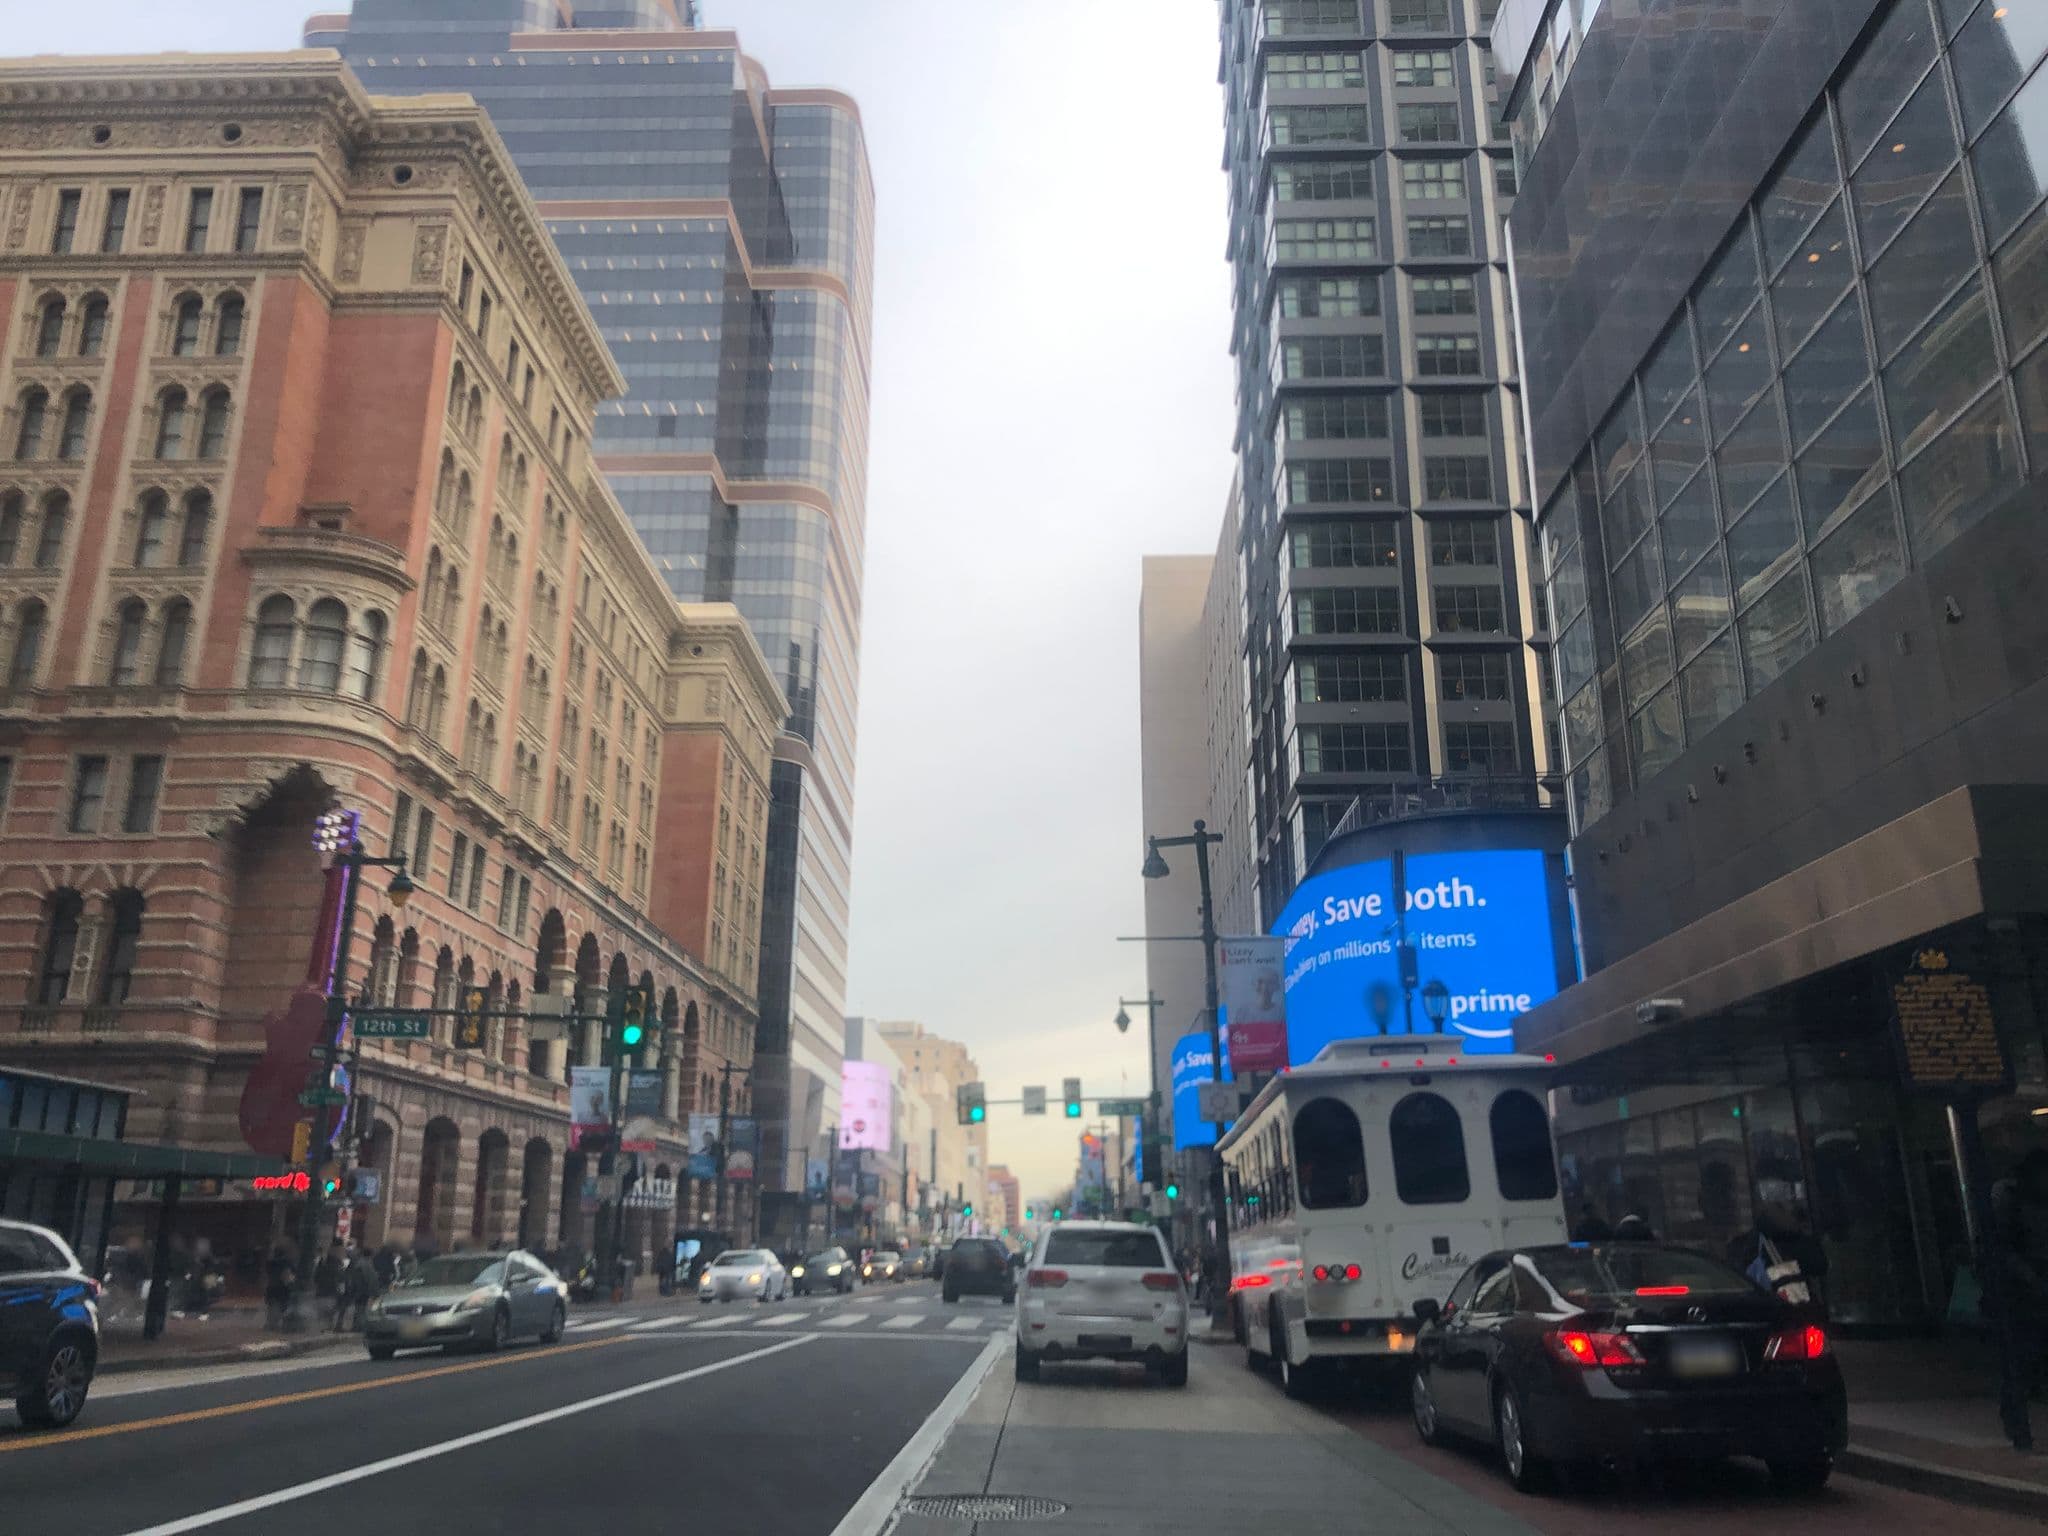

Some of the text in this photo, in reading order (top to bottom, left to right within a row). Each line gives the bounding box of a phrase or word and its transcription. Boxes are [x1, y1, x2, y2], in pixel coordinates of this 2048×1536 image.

[1323, 893, 1382, 926] Save
[1318, 950, 1332, 966] on
[1333, 938, 1391, 961] millions
[1421, 931, 1477, 950] items
[1451, 988, 1533, 1019] prime
[362, 1019, 421, 1033] 12th St
